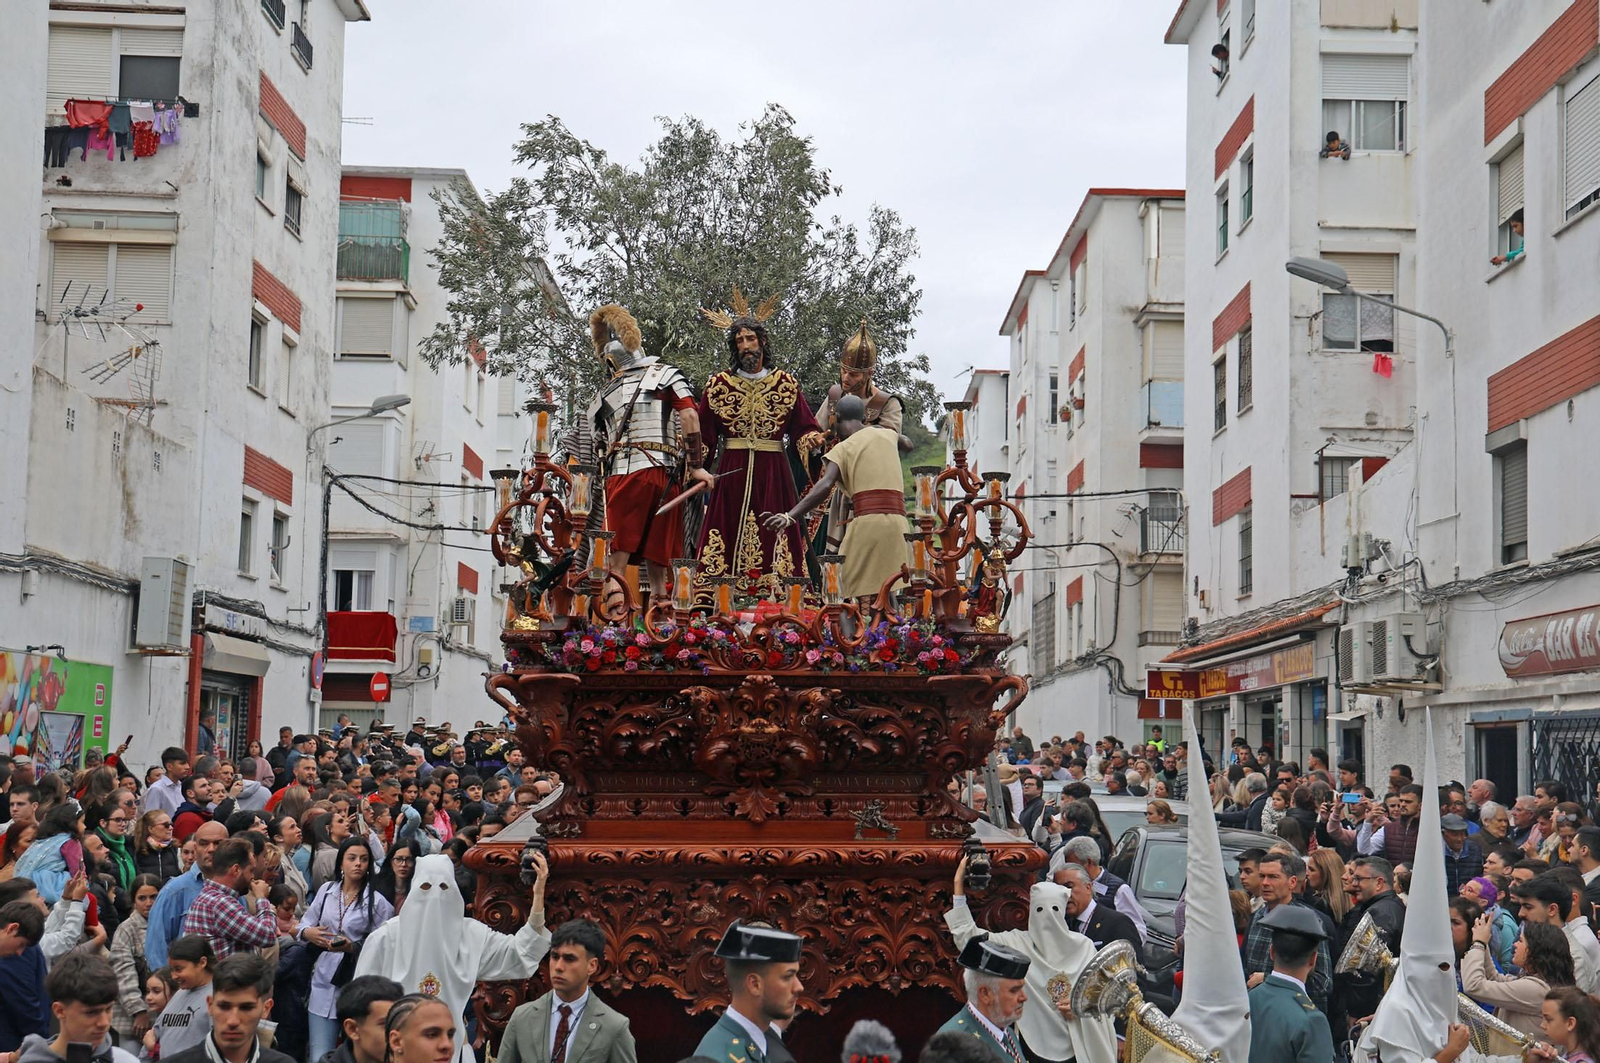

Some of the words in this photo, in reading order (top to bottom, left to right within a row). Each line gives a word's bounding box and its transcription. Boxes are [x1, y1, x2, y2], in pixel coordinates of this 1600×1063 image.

[1545, 617, 1577, 662] BAR
[1284, 644, 1313, 675] TABACOS
[1149, 689, 1195, 698] TABACOS
[161, 1013, 191, 1027] PUMA
